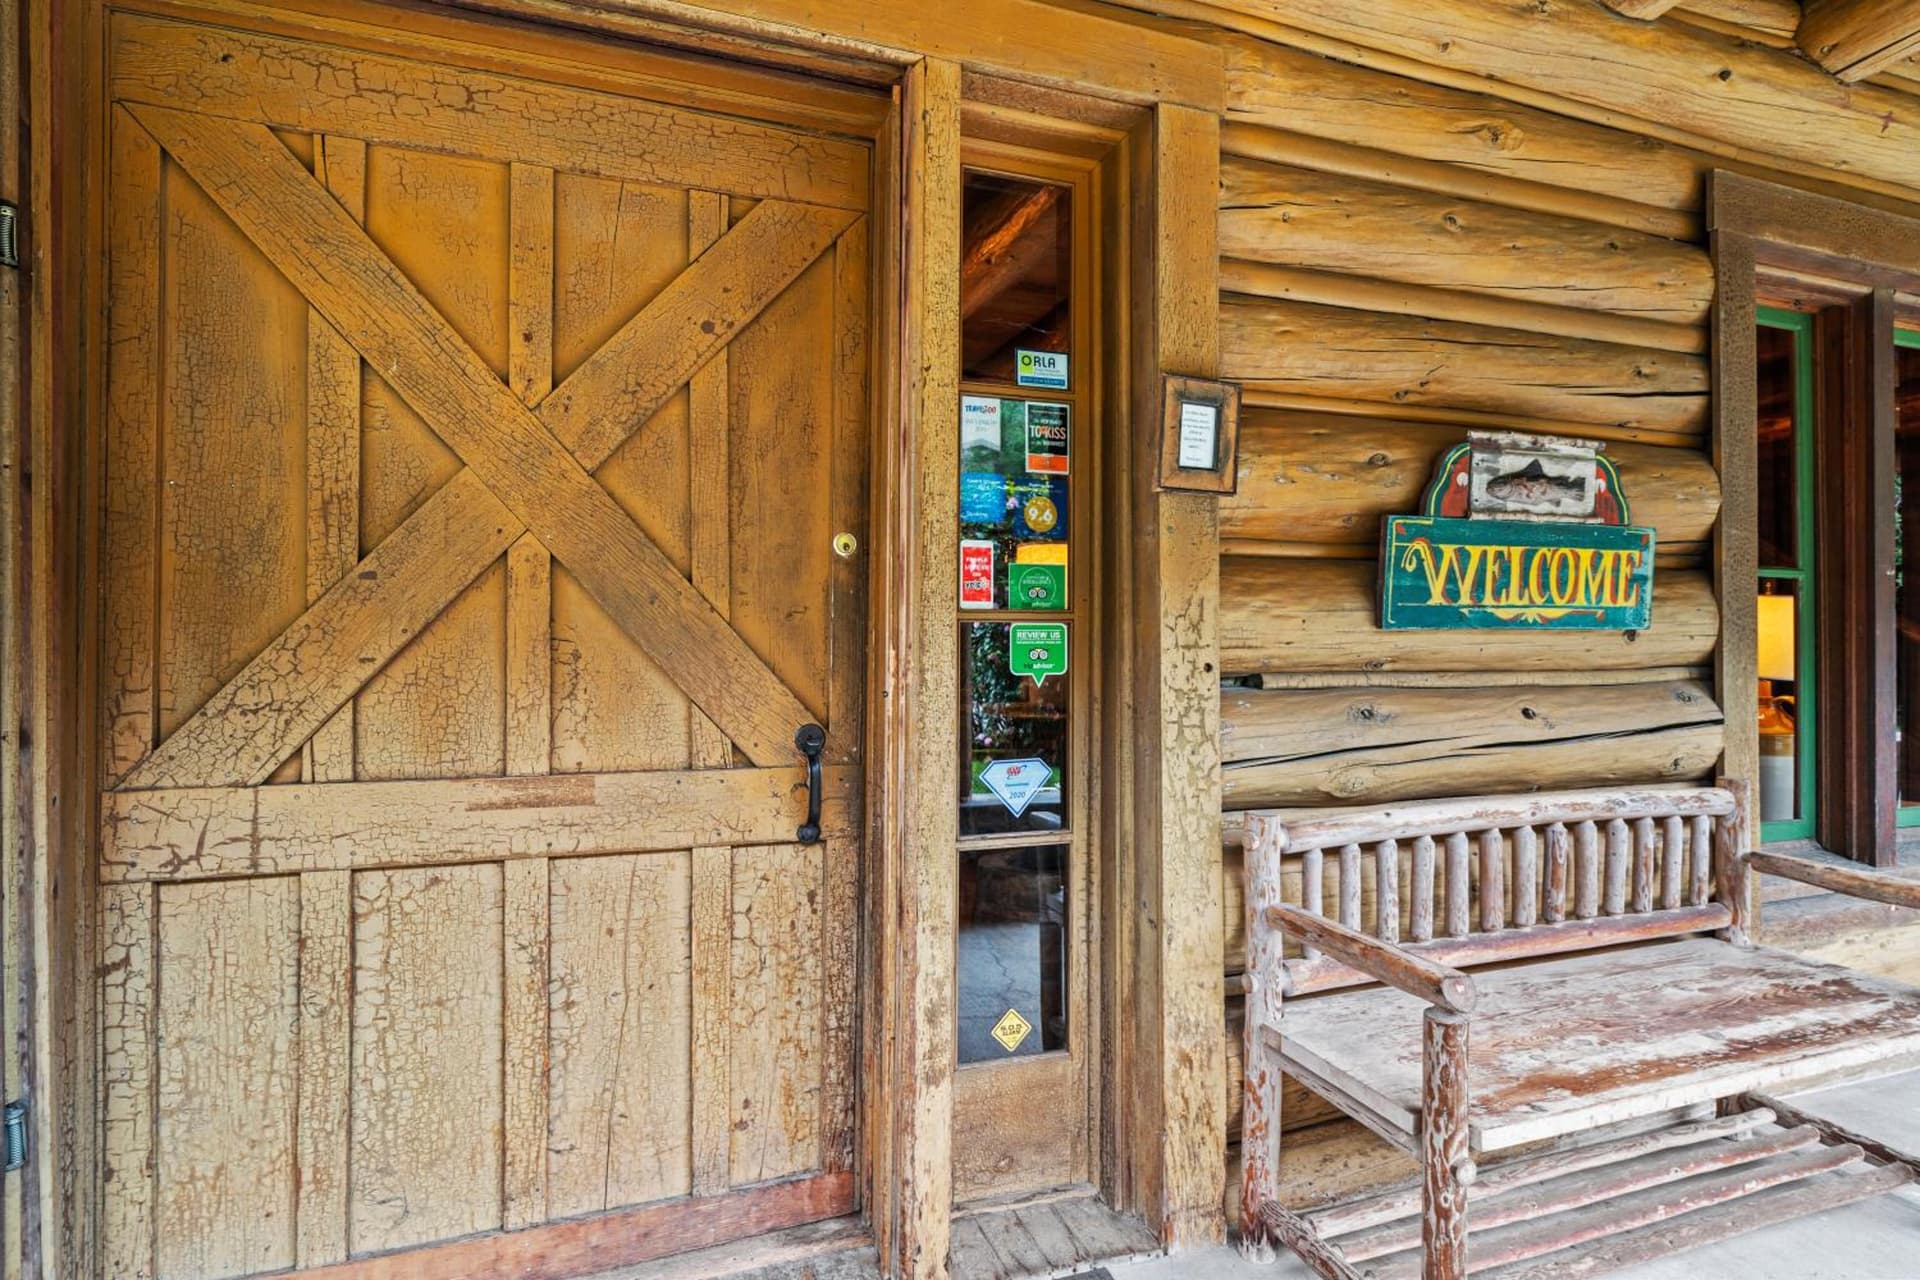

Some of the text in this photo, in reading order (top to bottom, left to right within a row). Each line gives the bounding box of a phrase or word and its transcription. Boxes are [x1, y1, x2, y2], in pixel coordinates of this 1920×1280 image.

[1021, 355, 1056, 369] ORLA
[1045, 426, 1067, 440] KISS
[1028, 507, 1053, 524] 9.6
[1401, 538, 1643, 607] WELCOME
[1017, 631, 1061, 640] REVIEW US
[1008, 791, 1026, 799] 2020
